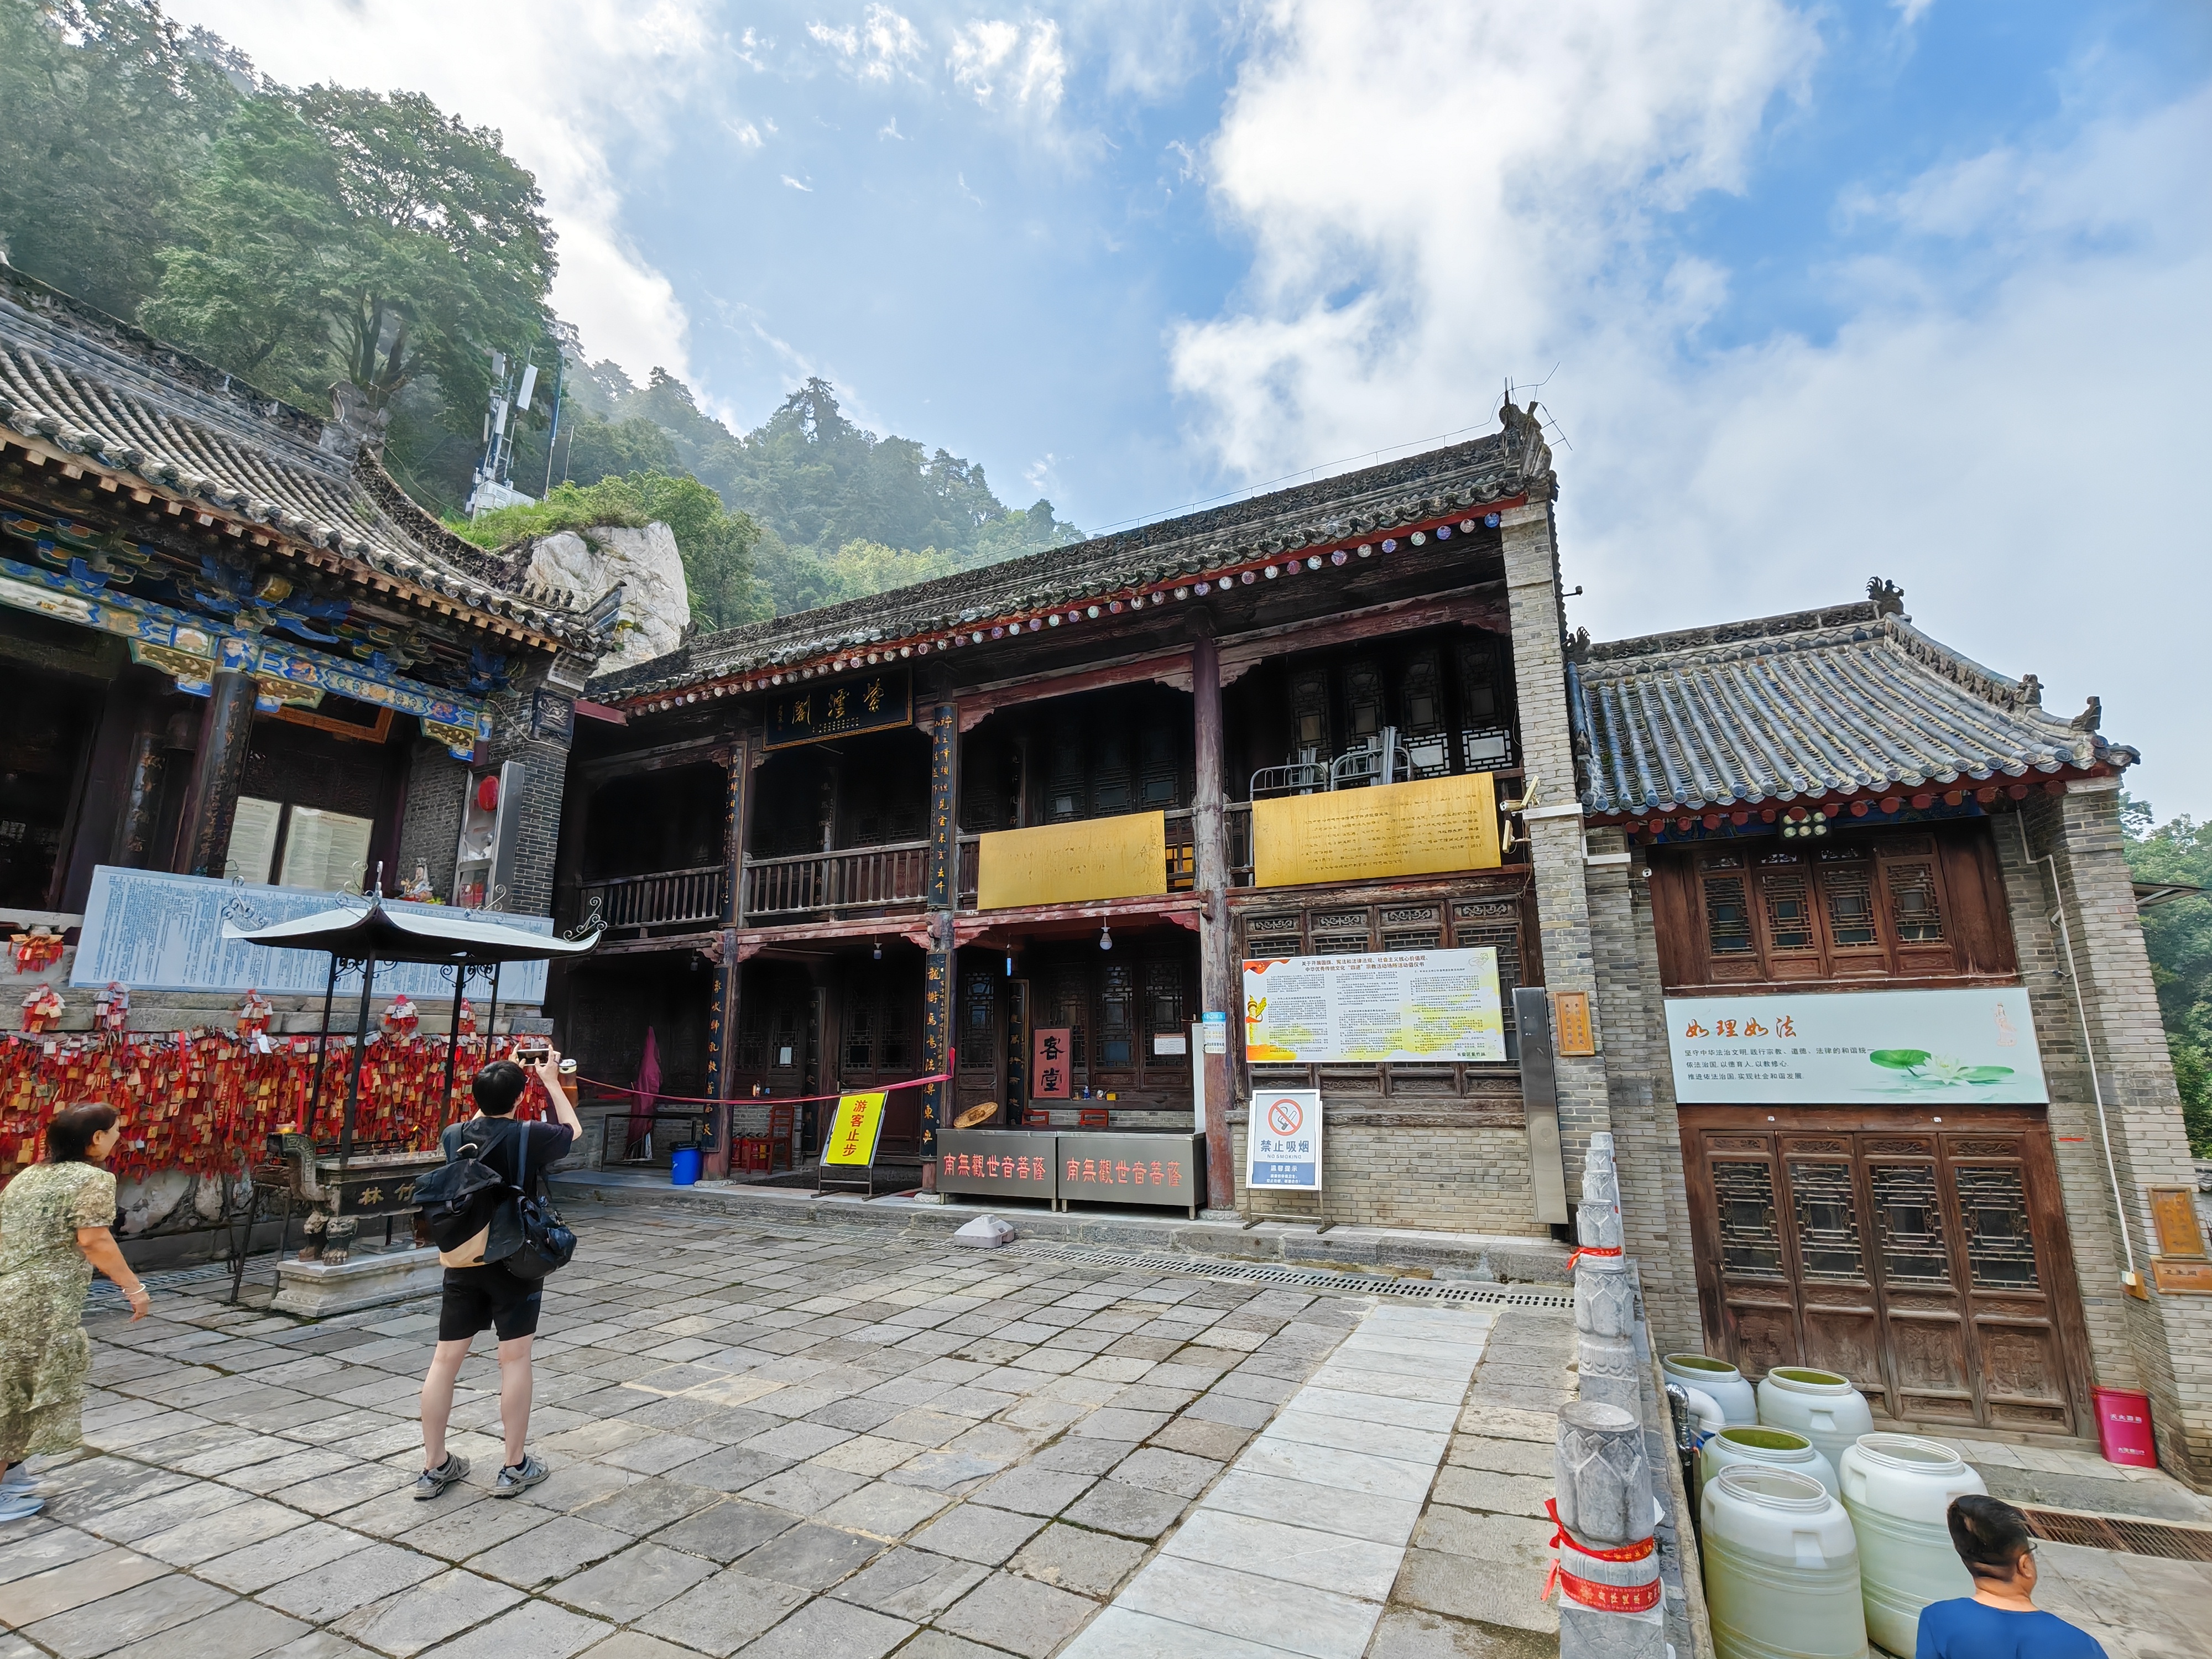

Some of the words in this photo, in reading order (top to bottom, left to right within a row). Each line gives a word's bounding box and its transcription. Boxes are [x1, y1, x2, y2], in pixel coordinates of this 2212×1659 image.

[1686, 1015, 1797, 1038] 如理如法
[1040, 1035, 1066, 1092] 客堂
[842, 1099, 868, 1157] 游客止步
[1260, 1140, 1310, 1153] 禁止吸烟
[943, 1152, 1046, 1181] 南無觀世音菩薩
[1066, 1156, 1183, 1187] 南無觀世音菩薩
